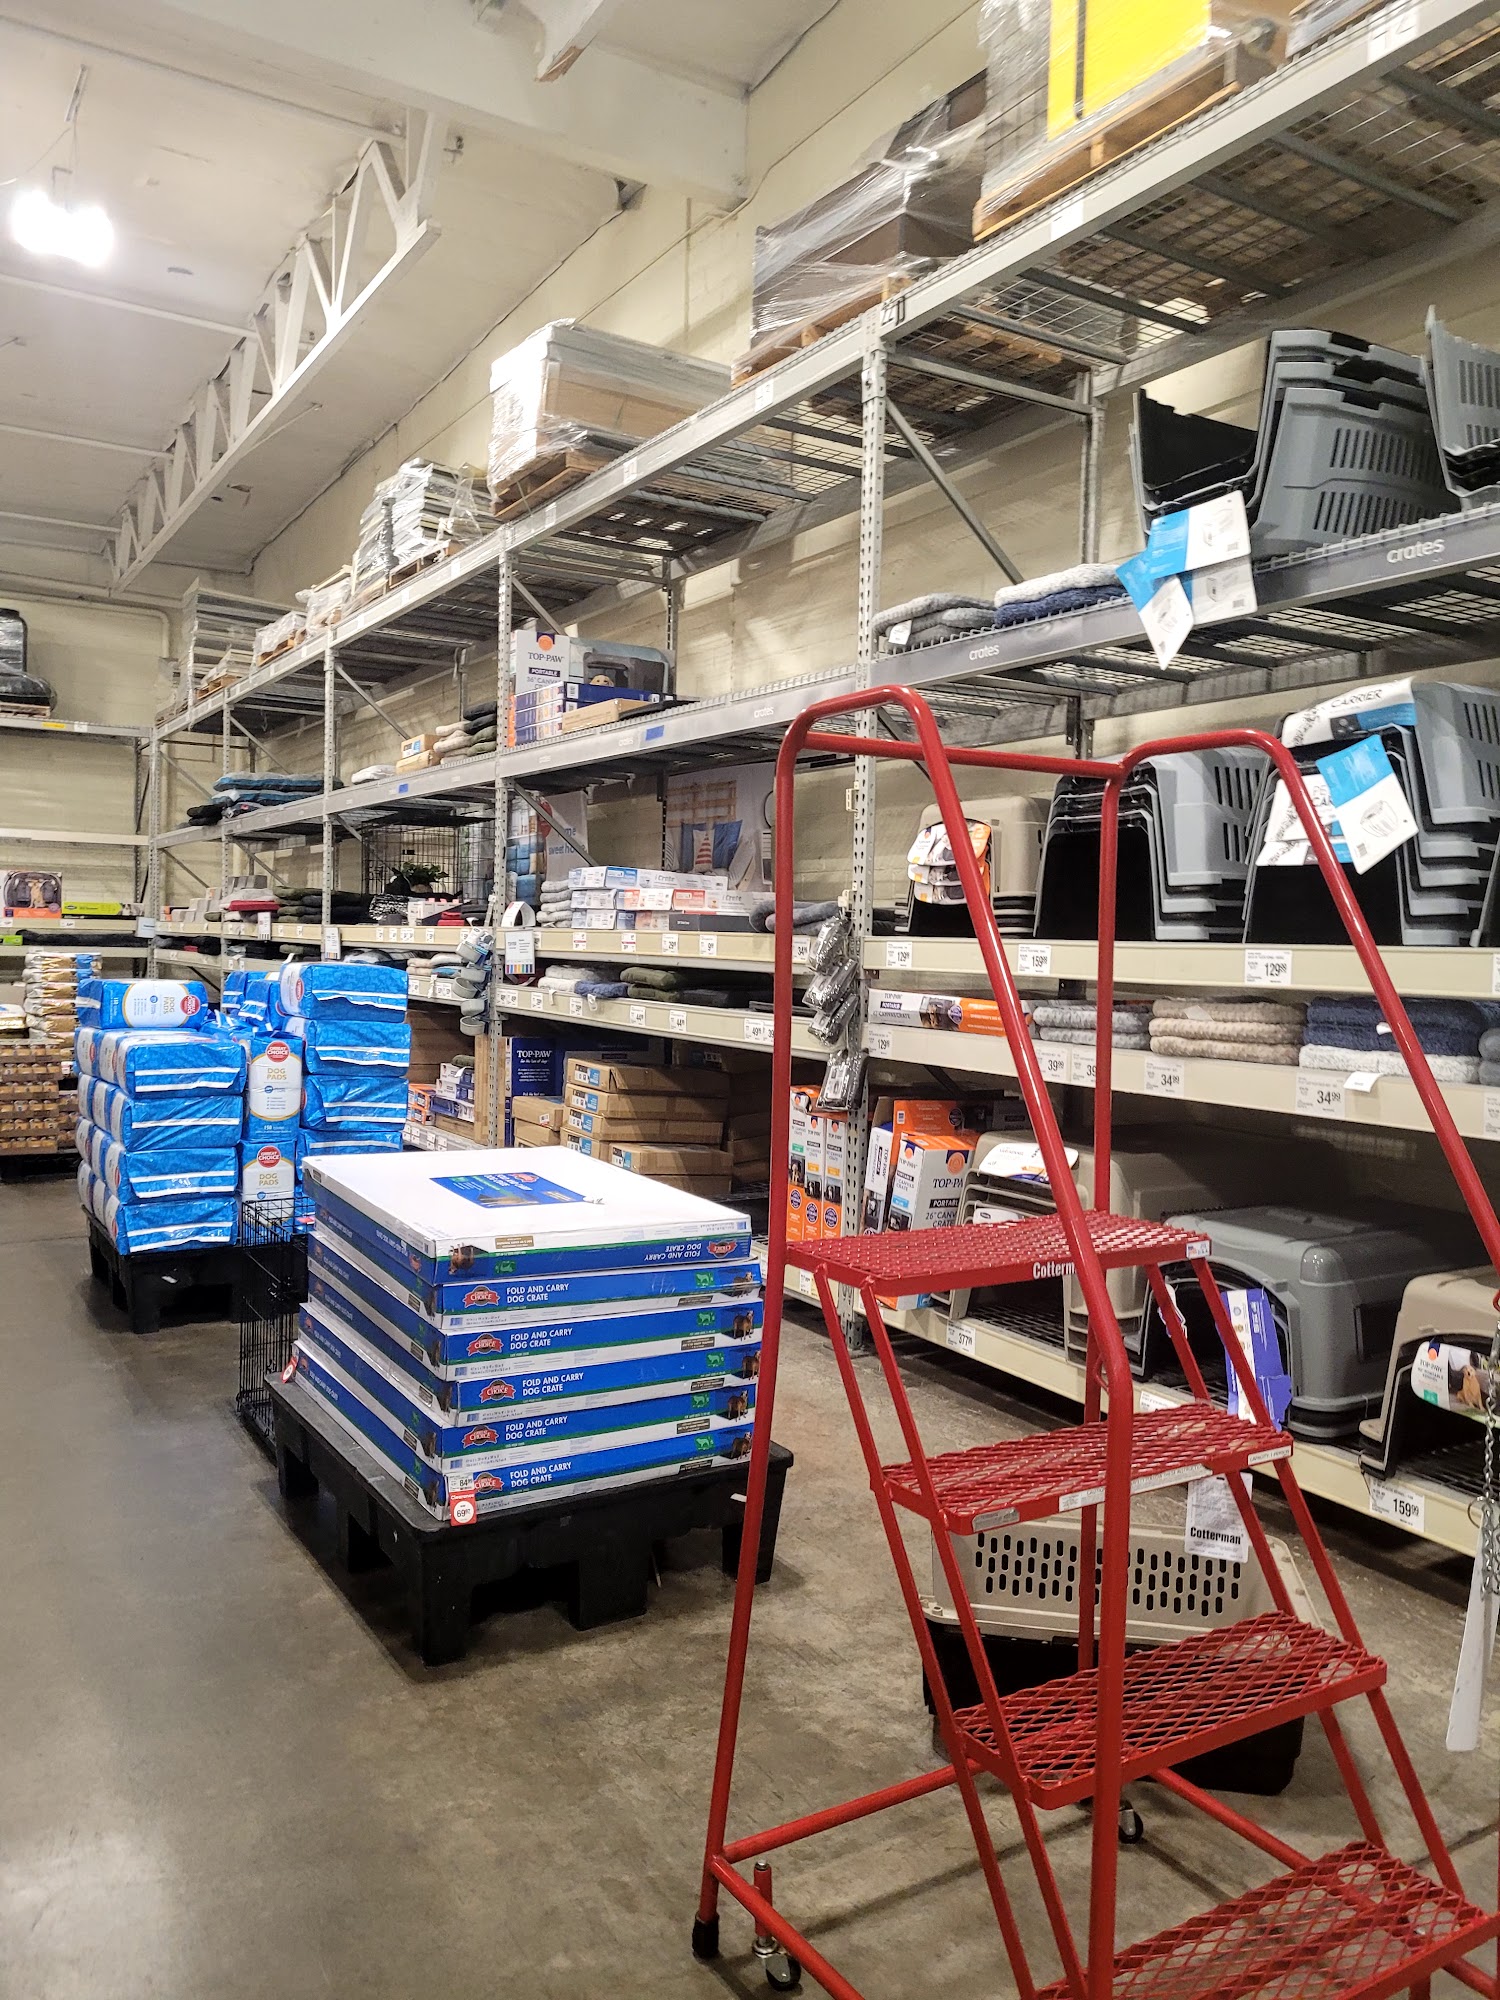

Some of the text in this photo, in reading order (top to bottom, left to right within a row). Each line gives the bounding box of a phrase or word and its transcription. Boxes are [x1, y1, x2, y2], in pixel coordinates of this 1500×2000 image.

[1386, 538, 1445, 563] crates
[969, 643, 1000, 661] crates
[531, 668, 558, 676] PORTABLE
[1331, 689, 1382, 708] CARRIER
[754, 706, 774, 719] crates
[933, 1200, 958, 1208] PORTABL
[926, 1211, 957, 1220] 26" CANV
[666, 1242, 702, 1252] DOG CRATE
[644, 1253, 666, 1262] CARRY
[1032, 1262, 1076, 1280] Cotterm
[506, 1283, 570, 1294] FOLD AND CARRY
[507, 1294, 548, 1304] DOG CRATE
[510, 1328, 573, 1342] FOLD AND CARRY
[510, 1340, 550, 1350] DOG CRATE
[522, 1373, 584, 1388] FOLD AND CARRY
[522, 1384, 564, 1396] DOG CRATE
[506, 1416, 568, 1432] FOLD AND CARRY
[469, 1432, 491, 1440] CHOICE
[505, 1428, 546, 1440] DOG CRATE
[1250, 1454, 1270, 1463] CAPACITY
[510, 1462, 572, 1478] FOLD AND CARRY
[474, 1480, 496, 1488] CHOICE
[511, 1474, 552, 1488] DOG CRATE
[1190, 1526, 1241, 1544] Cotterman
